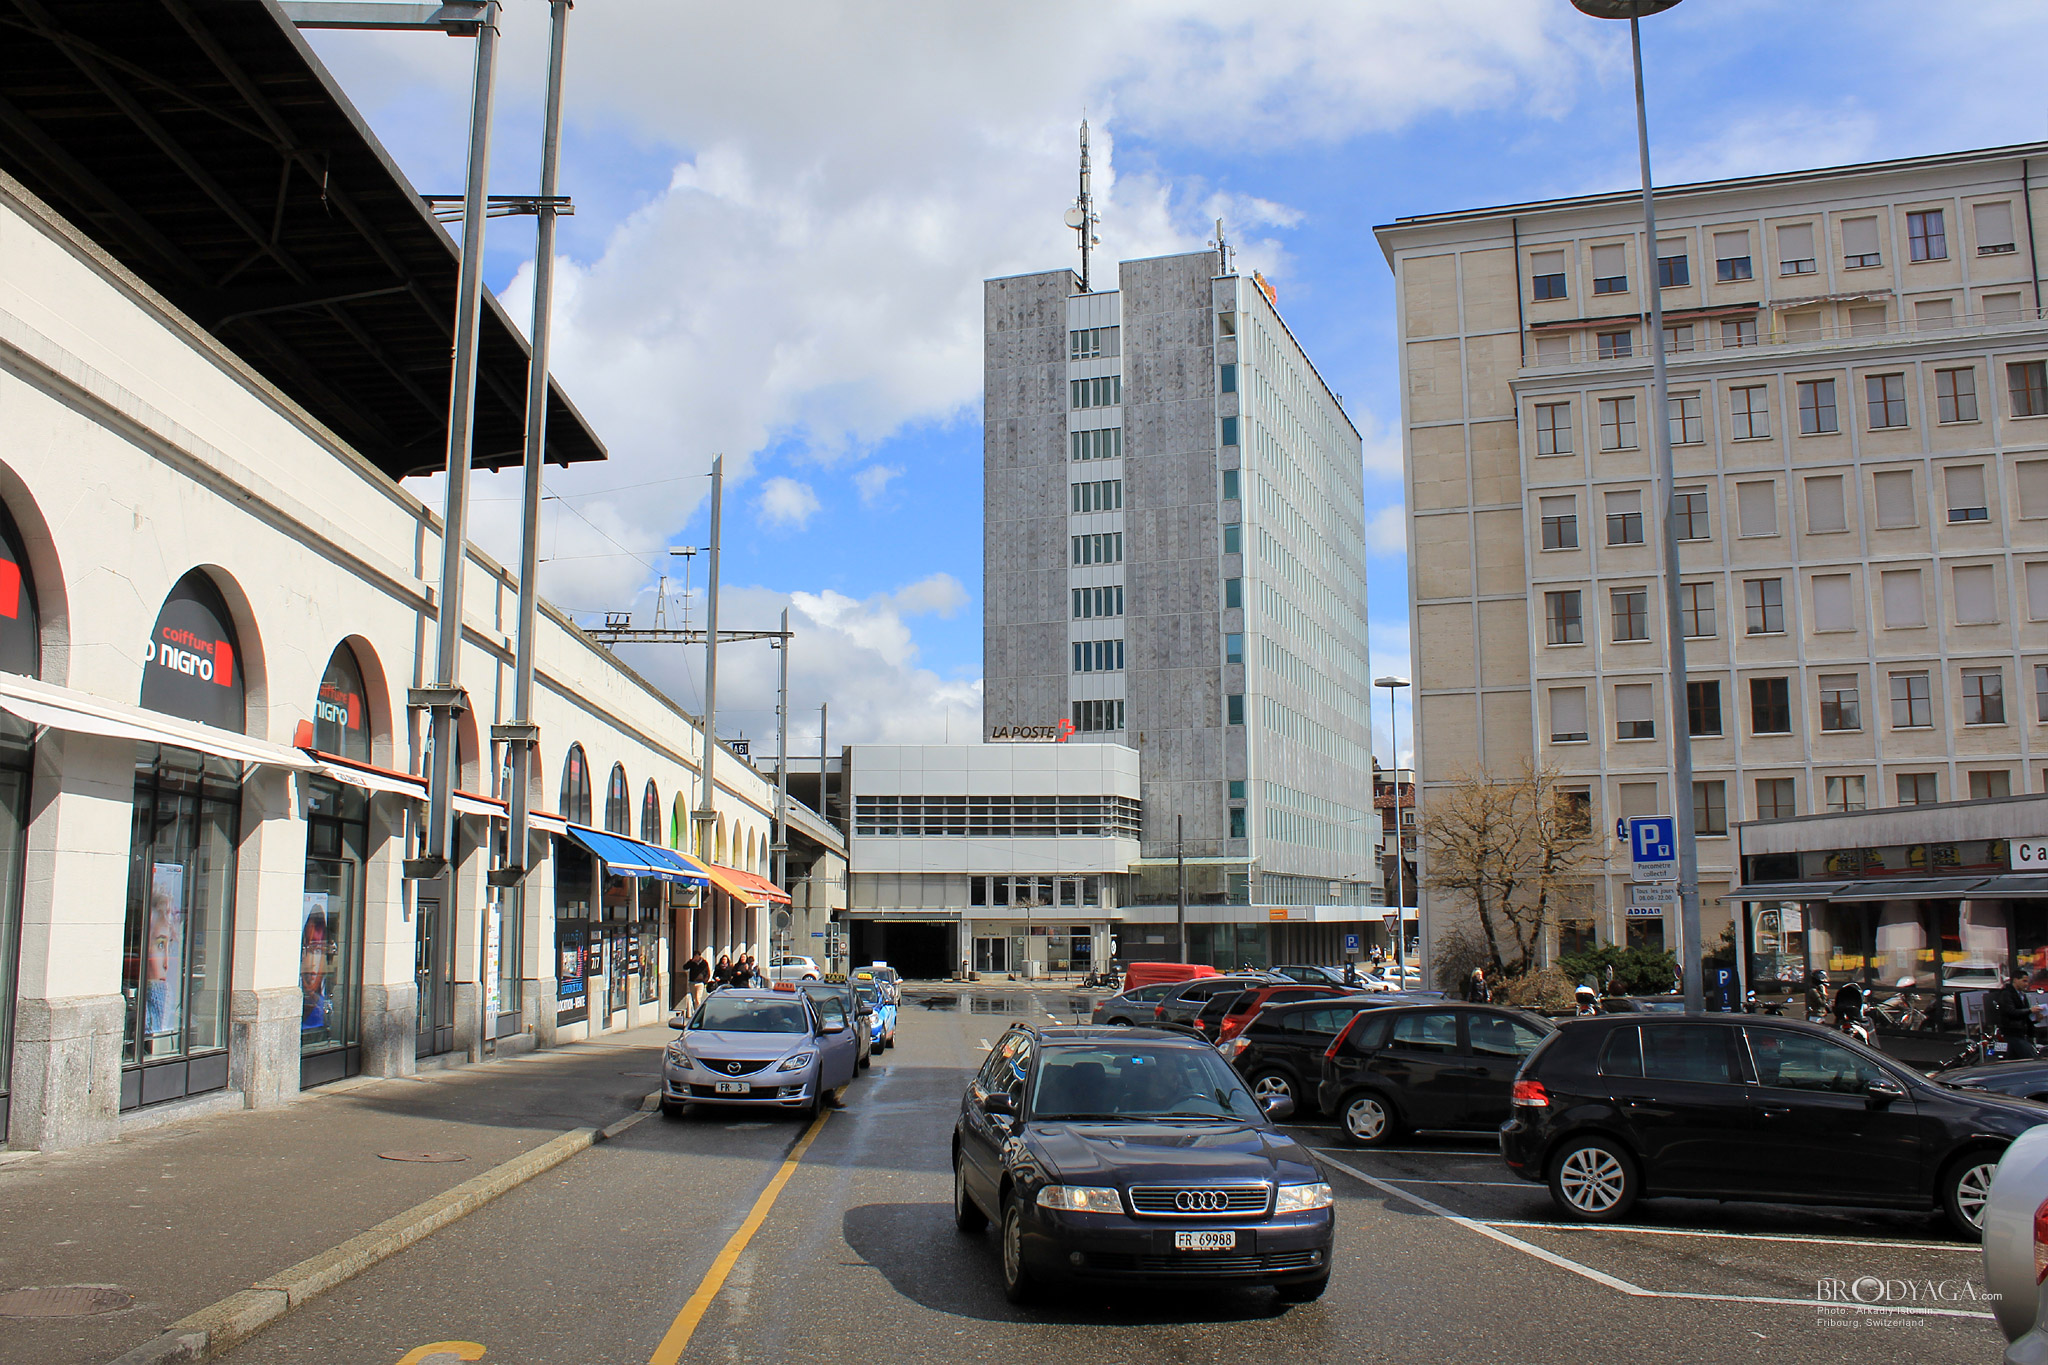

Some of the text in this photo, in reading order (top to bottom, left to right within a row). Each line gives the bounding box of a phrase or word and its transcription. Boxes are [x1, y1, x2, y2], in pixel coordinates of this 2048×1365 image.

[162, 627, 214, 654] coiffure
[992, 726, 1056, 739] LA POSTE
[1639, 824, 1660, 856] P
[1719, 970, 1729, 985] P
[720, 1083, 730, 1092] FR
[1178, 1233, 1232, 1246] FR 69988
